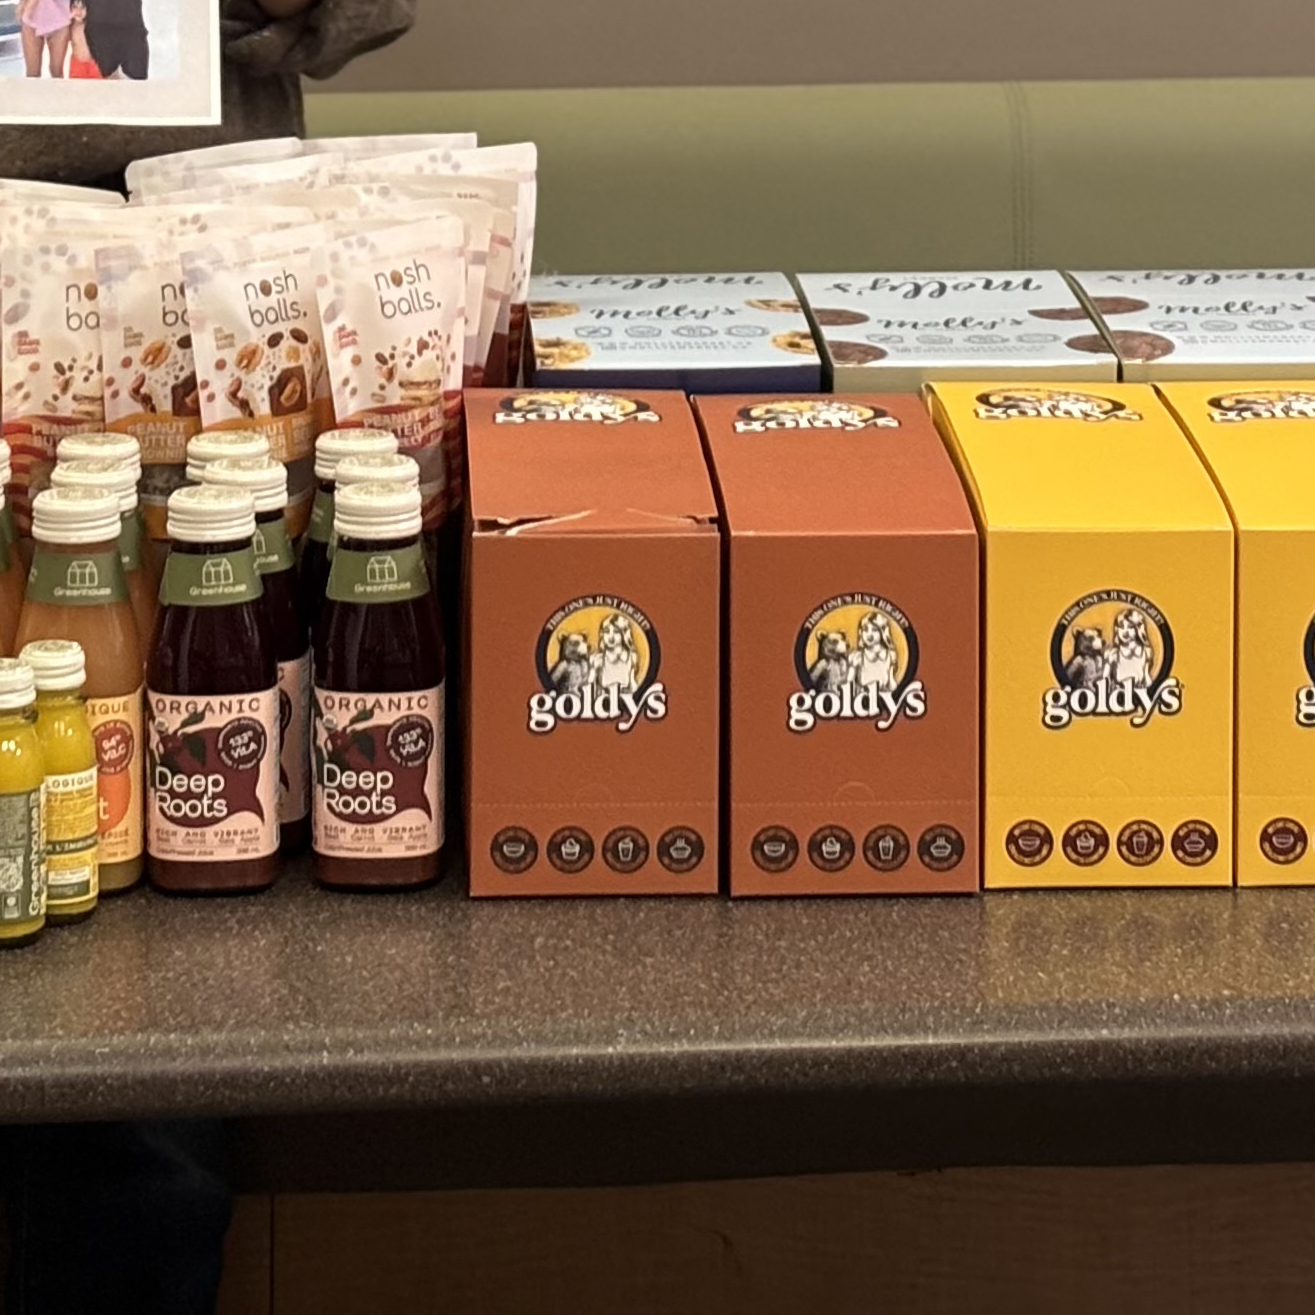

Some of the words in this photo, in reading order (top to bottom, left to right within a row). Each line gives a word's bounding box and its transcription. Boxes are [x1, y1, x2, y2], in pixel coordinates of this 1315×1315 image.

[244, 270, 298, 299] nosh
[374, 260, 431, 290] nosh
[248, 300, 308, 328] balls.
[379, 290, 442, 319] balls.
[590, 304, 741, 320] molly's
[876, 316, 1028, 331] molly's
[53, 586, 113, 597] Greenhouse
[155, 697, 261, 714] ORGANIC
[324, 695, 429, 712] ORGANIC
[528, 682, 667, 734] goldys
[788, 681, 927, 733] goldys
[1042, 677, 1183, 729] goldys
[156, 766, 226, 795] Deep
[323, 764, 394, 794] Deep
[156, 792, 228, 818] Roots
[324, 789, 397, 816] Roots
